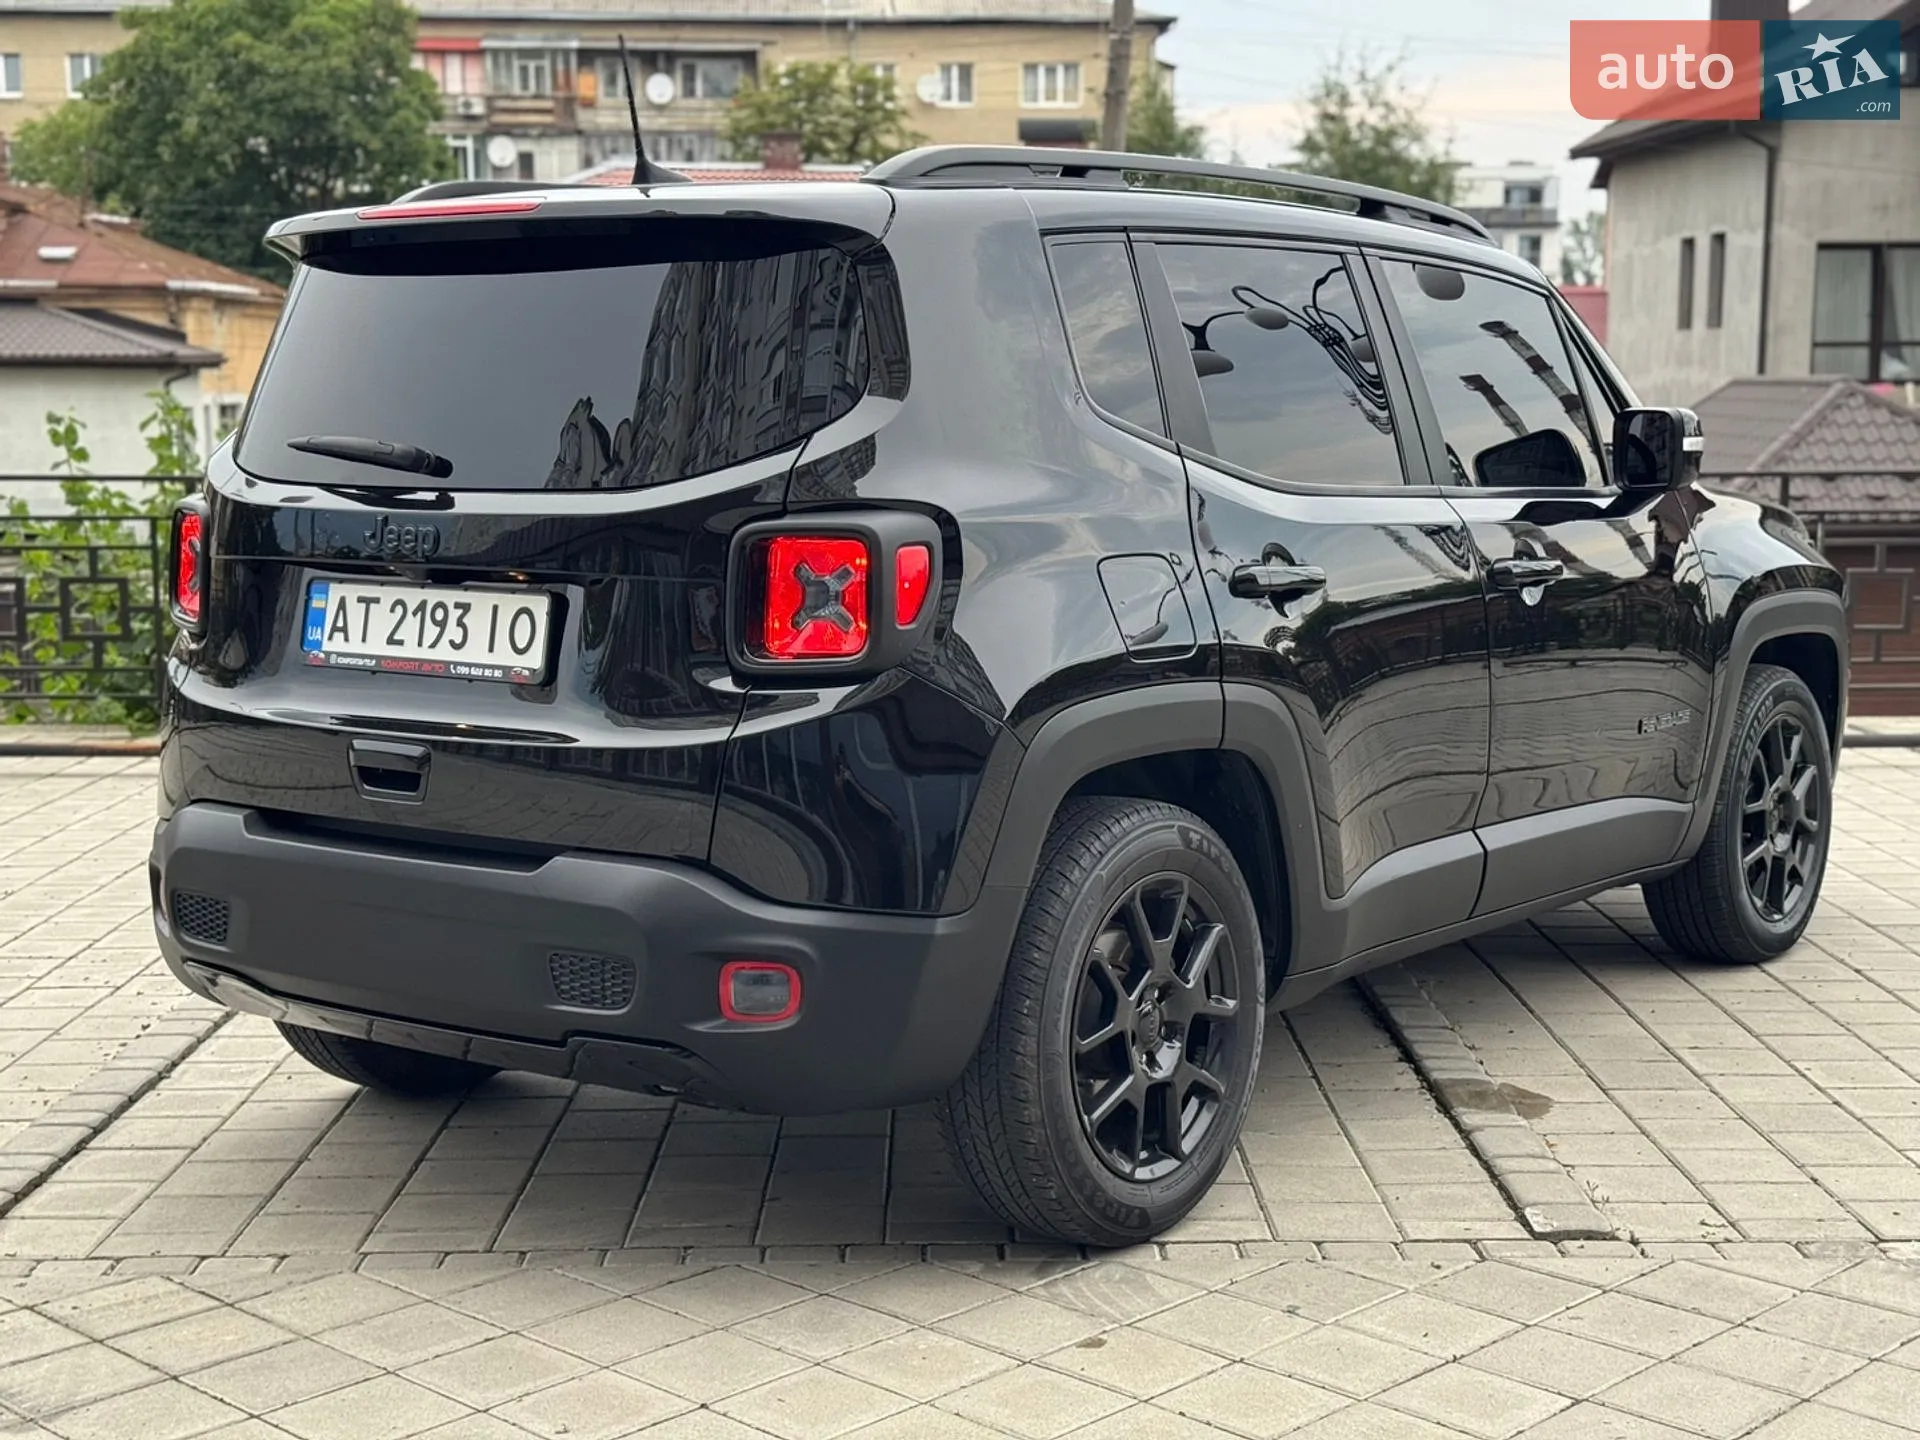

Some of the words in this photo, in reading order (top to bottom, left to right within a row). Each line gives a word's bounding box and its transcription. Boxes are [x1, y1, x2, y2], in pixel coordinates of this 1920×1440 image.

[363, 513, 439, 561] Jeep
[307, 628, 323, 641] UA
[327, 595, 381, 643] AT
[386, 598, 472, 650] 2193
[488, 603, 537, 656] IO
